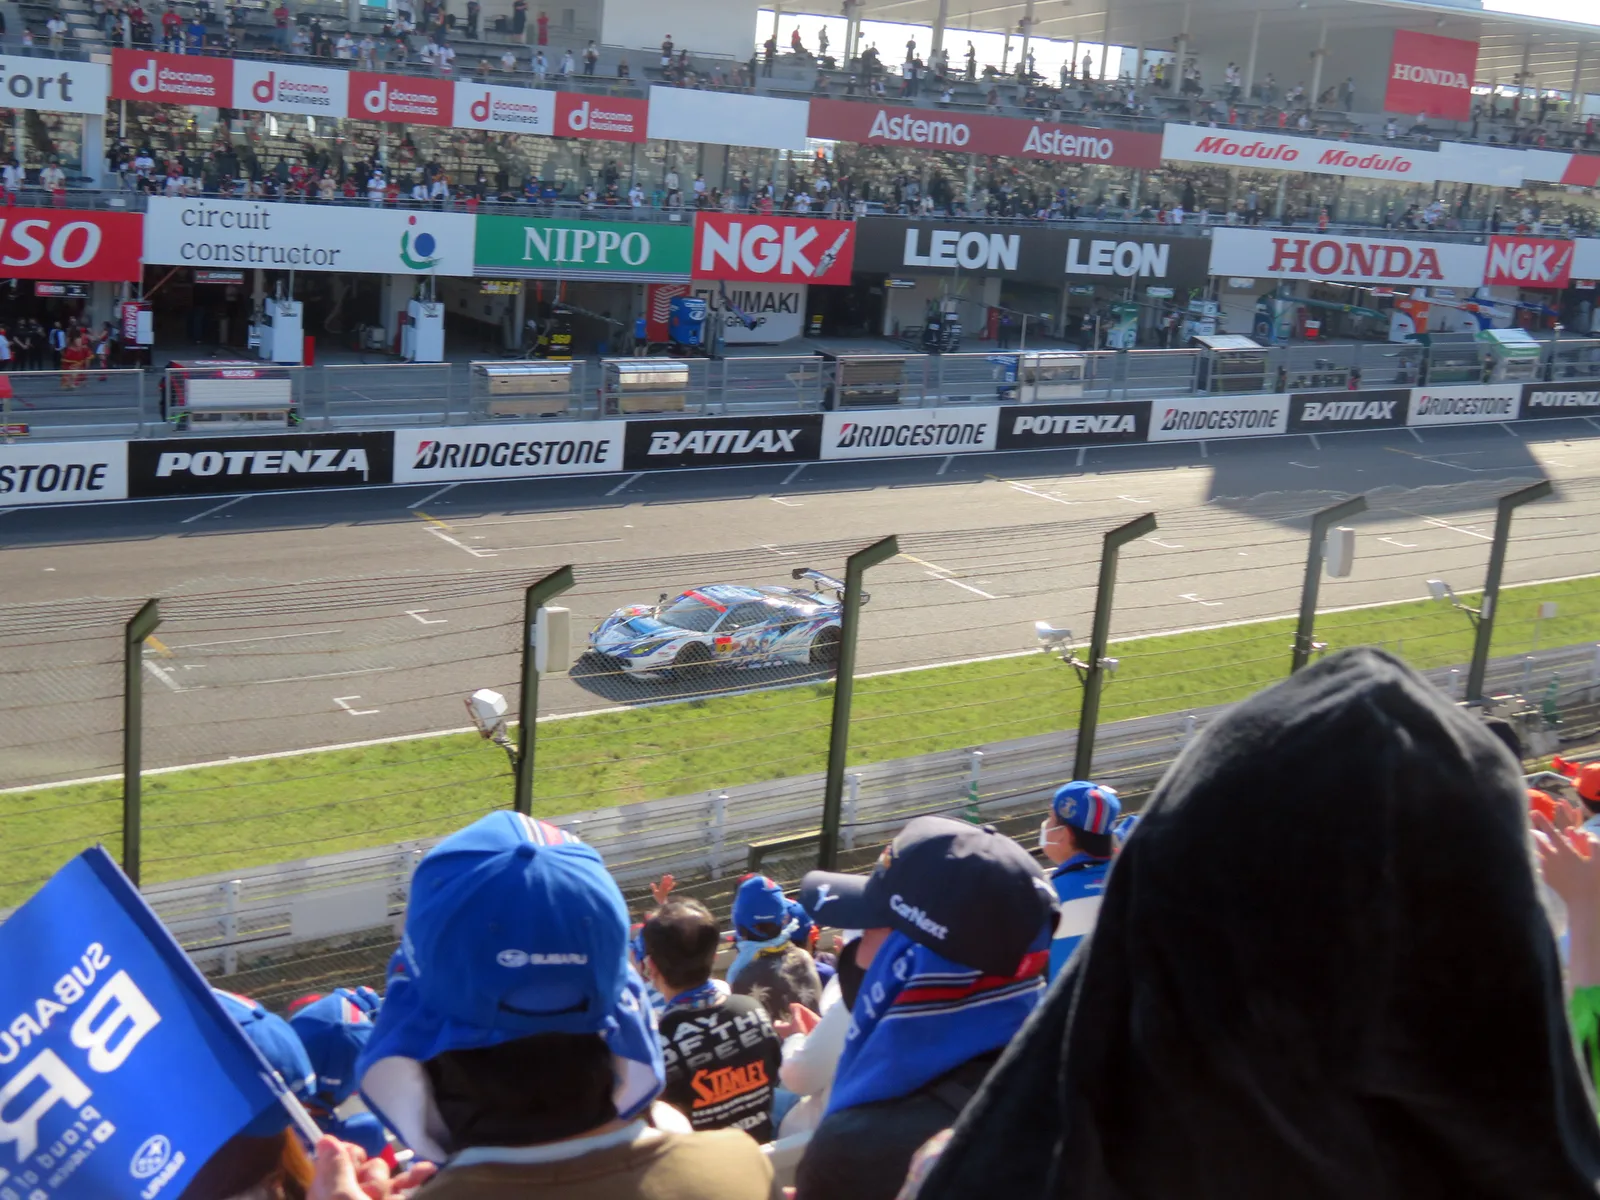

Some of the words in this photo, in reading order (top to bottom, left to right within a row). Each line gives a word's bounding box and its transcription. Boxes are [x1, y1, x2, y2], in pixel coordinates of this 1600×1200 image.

[158, 79, 216, 97] business
[159, 68, 215, 85] docomo
[278, 80, 329, 94] docomo
[1392, 63, 1470, 91] HONDA
[278, 90, 331, 106] business
[388, 101, 439, 116] business
[389, 89, 437, 104] docomo
[493, 100, 538, 113] docomo
[492, 109, 539, 125] business
[589, 119, 634, 133] business
[590, 108, 634, 122] docomo
[868, 109, 970, 147] Astemo
[1023, 125, 1114, 160] Astemo
[1195, 135, 1299, 162] Modulo
[1318, 149, 1413, 173] Modulo
[181, 202, 271, 231] circuit
[0, 218, 102, 270] SO
[180, 233, 342, 267] constructor
[522, 226, 650, 266] NIPPO
[700, 221, 819, 277] NGK
[903, 228, 1021, 271] LEON
[1065, 238, 1170, 278] LEON
[1268, 237, 1444, 281] HONDA
[1488, 242, 1555, 282] NGK
[1300, 400, 1397, 421] BATTLAX
[1416, 394, 1514, 416] BRIDGESTONE
[1528, 389, 1600, 407] POTENZ
[1012, 414, 1136, 435] POTENZA
[1160, 408, 1280, 431] BRIDGESTONE
[647, 428, 801, 455] BATTLAX
[836, 422, 987, 448] BRIDGESTONE
[156, 448, 370, 479] POTENZA
[413, 438, 610, 469] BRIDGESTONE
[0, 463, 108, 494] STONE
[889, 894, 949, 940] CarNext
[530, 953, 588, 965] SUBARU
[690, 1059, 769, 1109] STANLEY
